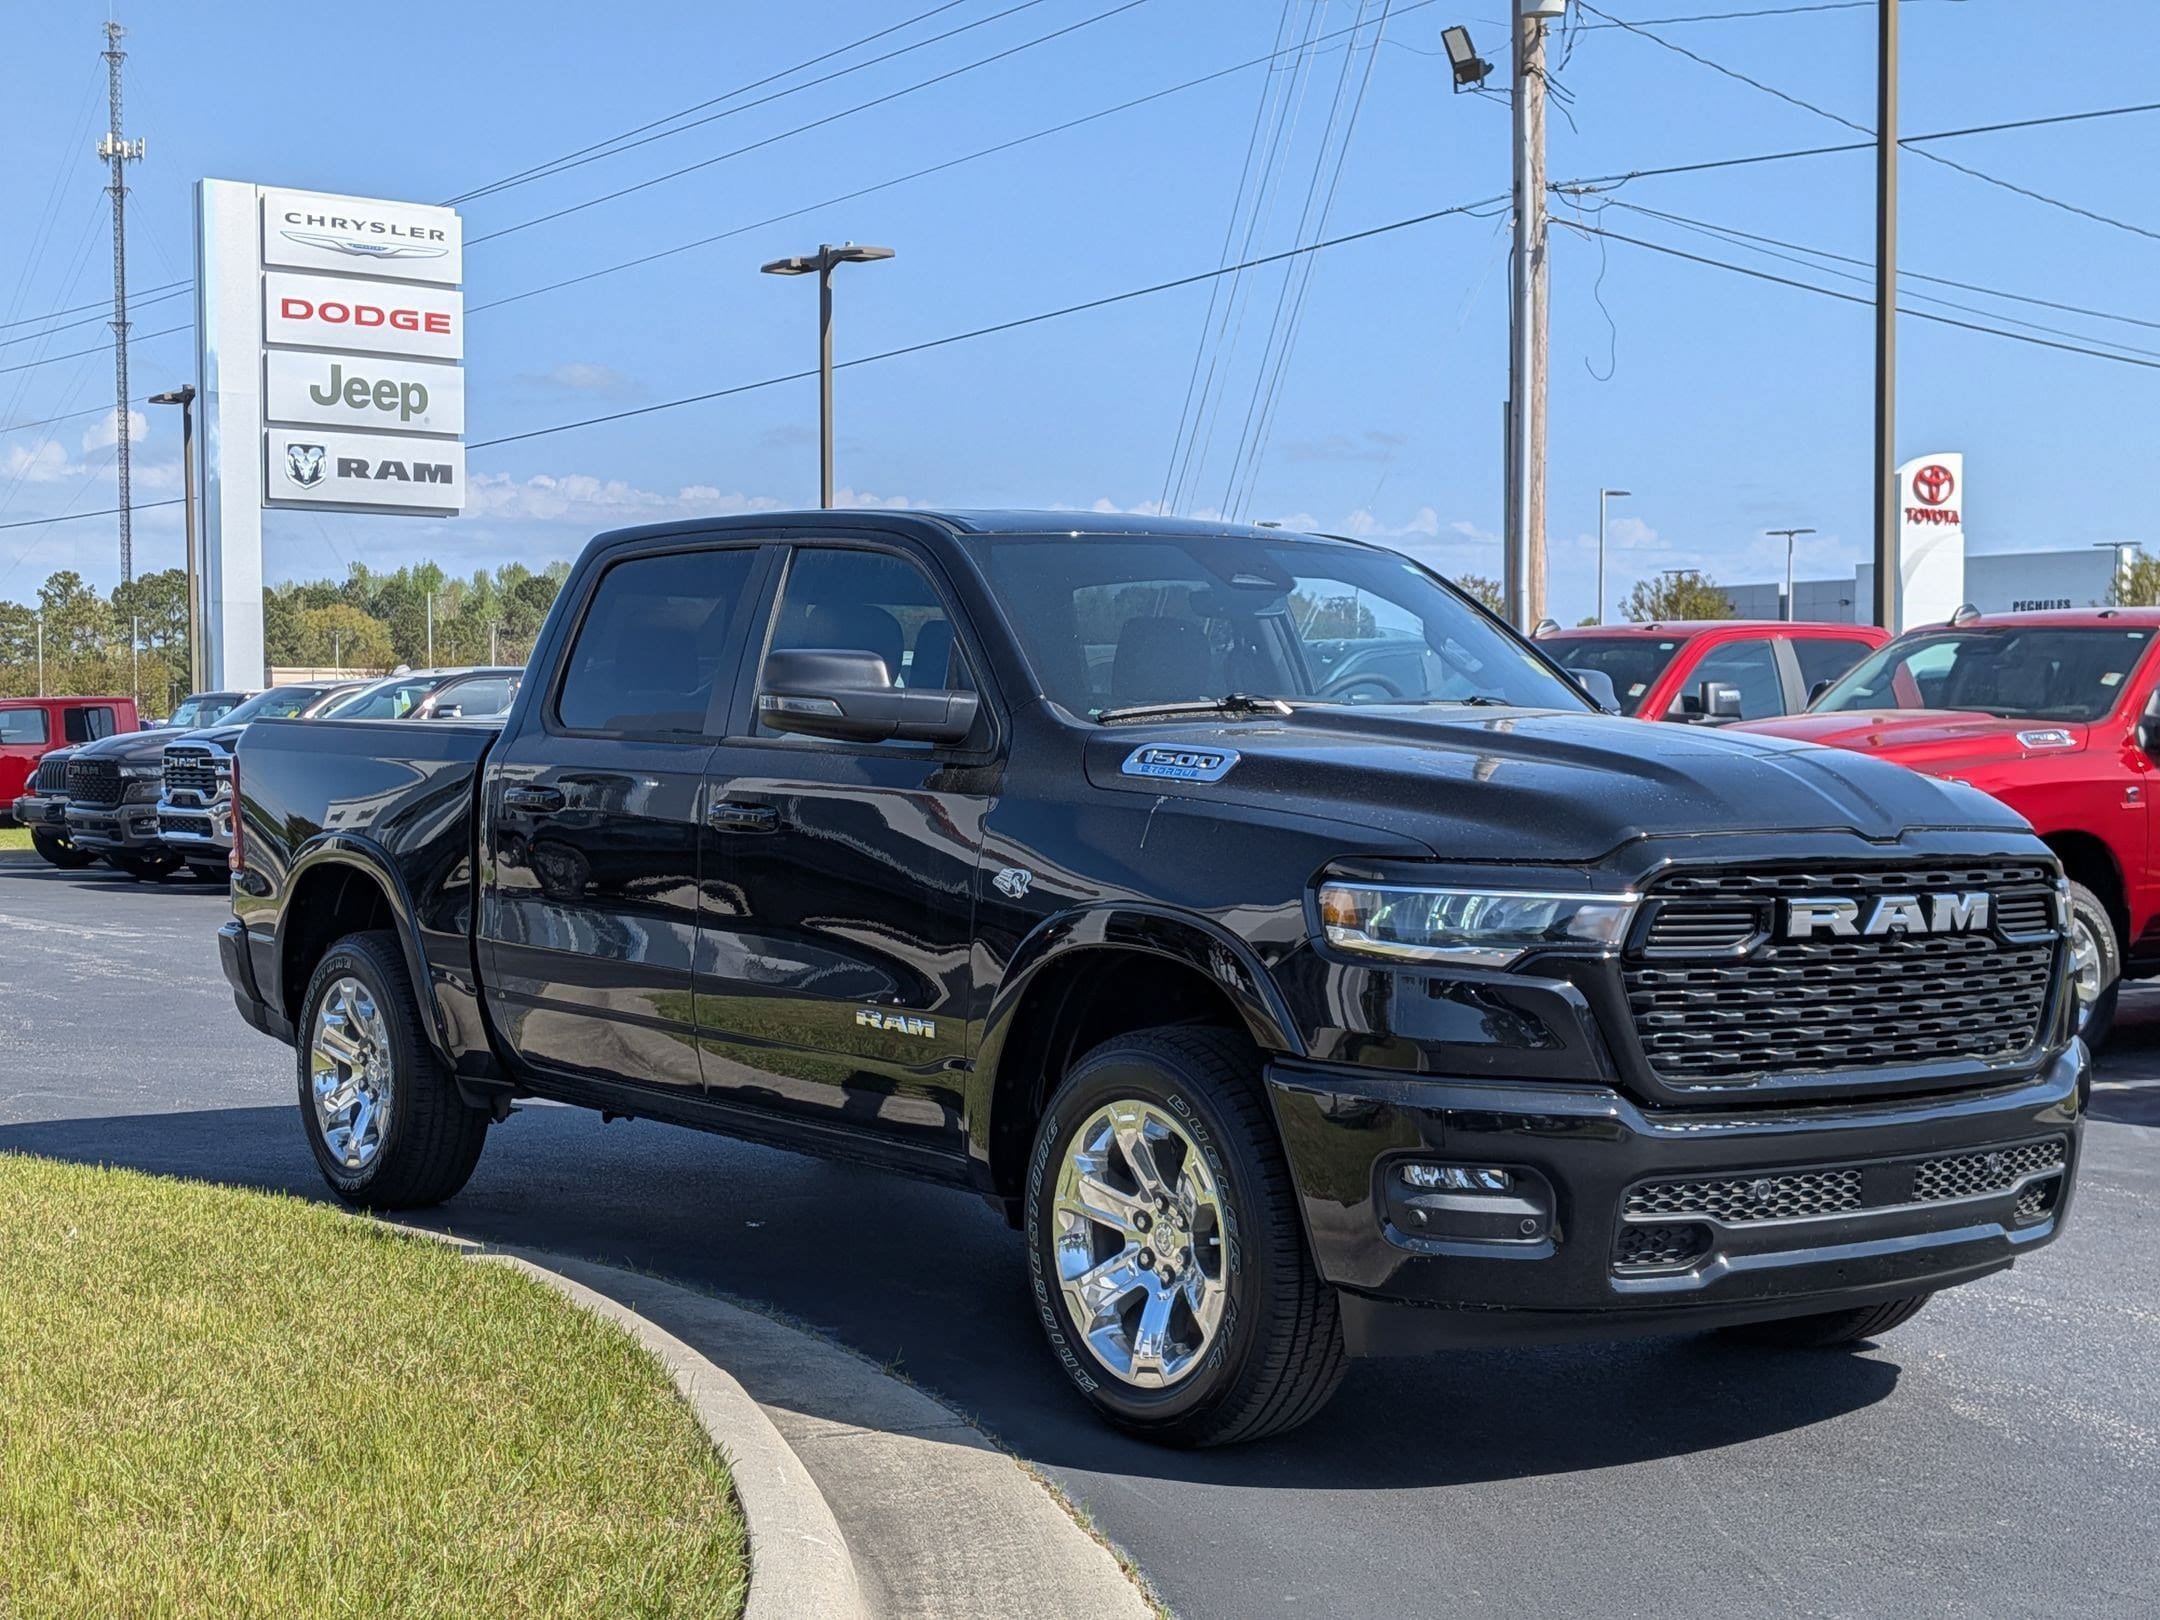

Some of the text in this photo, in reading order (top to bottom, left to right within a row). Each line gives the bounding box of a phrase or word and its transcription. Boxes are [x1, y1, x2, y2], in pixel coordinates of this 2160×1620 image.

[284, 212, 445, 241] CHRYSLER
[281, 298, 451, 334] DODGE
[309, 364, 429, 421] Jeep
[337, 457, 453, 484] RAM
[1905, 507, 1960, 525] TOYOTA
[2012, 598, 2071, 612] PECHELES
[1143, 750, 1220, 769] 1500
[1787, 892, 1989, 937] RAM
[856, 1009, 935, 1039] RAM
[1167, 1094, 1243, 1276] DUELER
[1027, 1115, 1099, 1393] BRIDGESTONE
